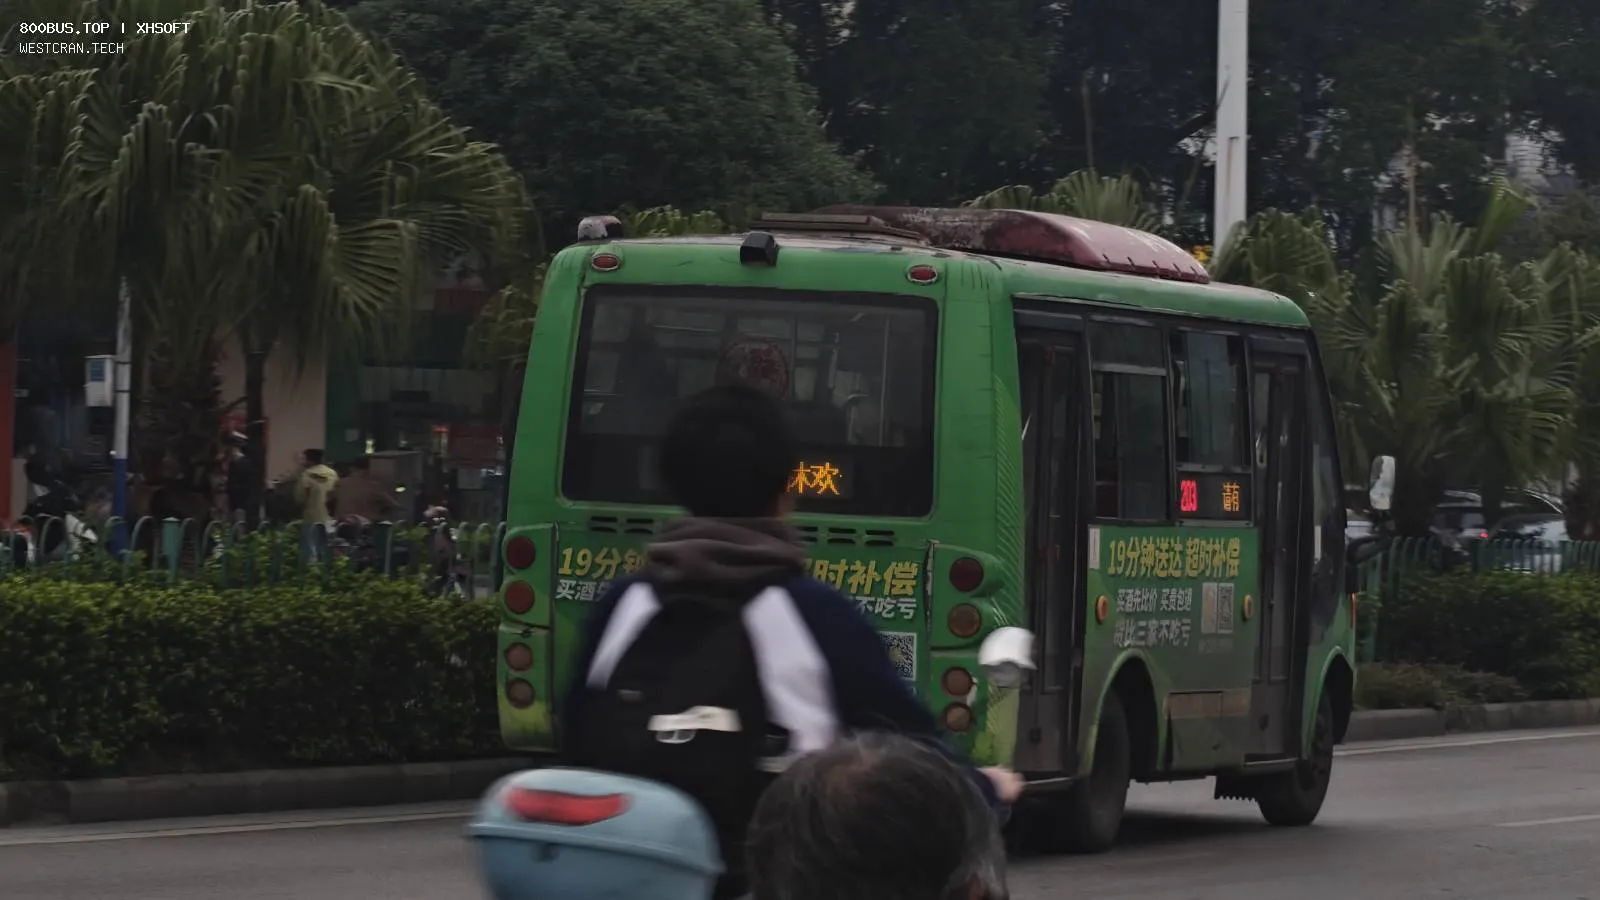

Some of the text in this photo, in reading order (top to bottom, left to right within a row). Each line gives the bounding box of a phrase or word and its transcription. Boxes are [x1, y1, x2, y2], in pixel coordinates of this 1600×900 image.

[803, 557, 919, 597] 时补偿
[1108, 537, 1182, 577] 19分钟送达
[1185, 537, 1240, 577] 超时补偿
[847, 594, 918, 620] 不吃亏
